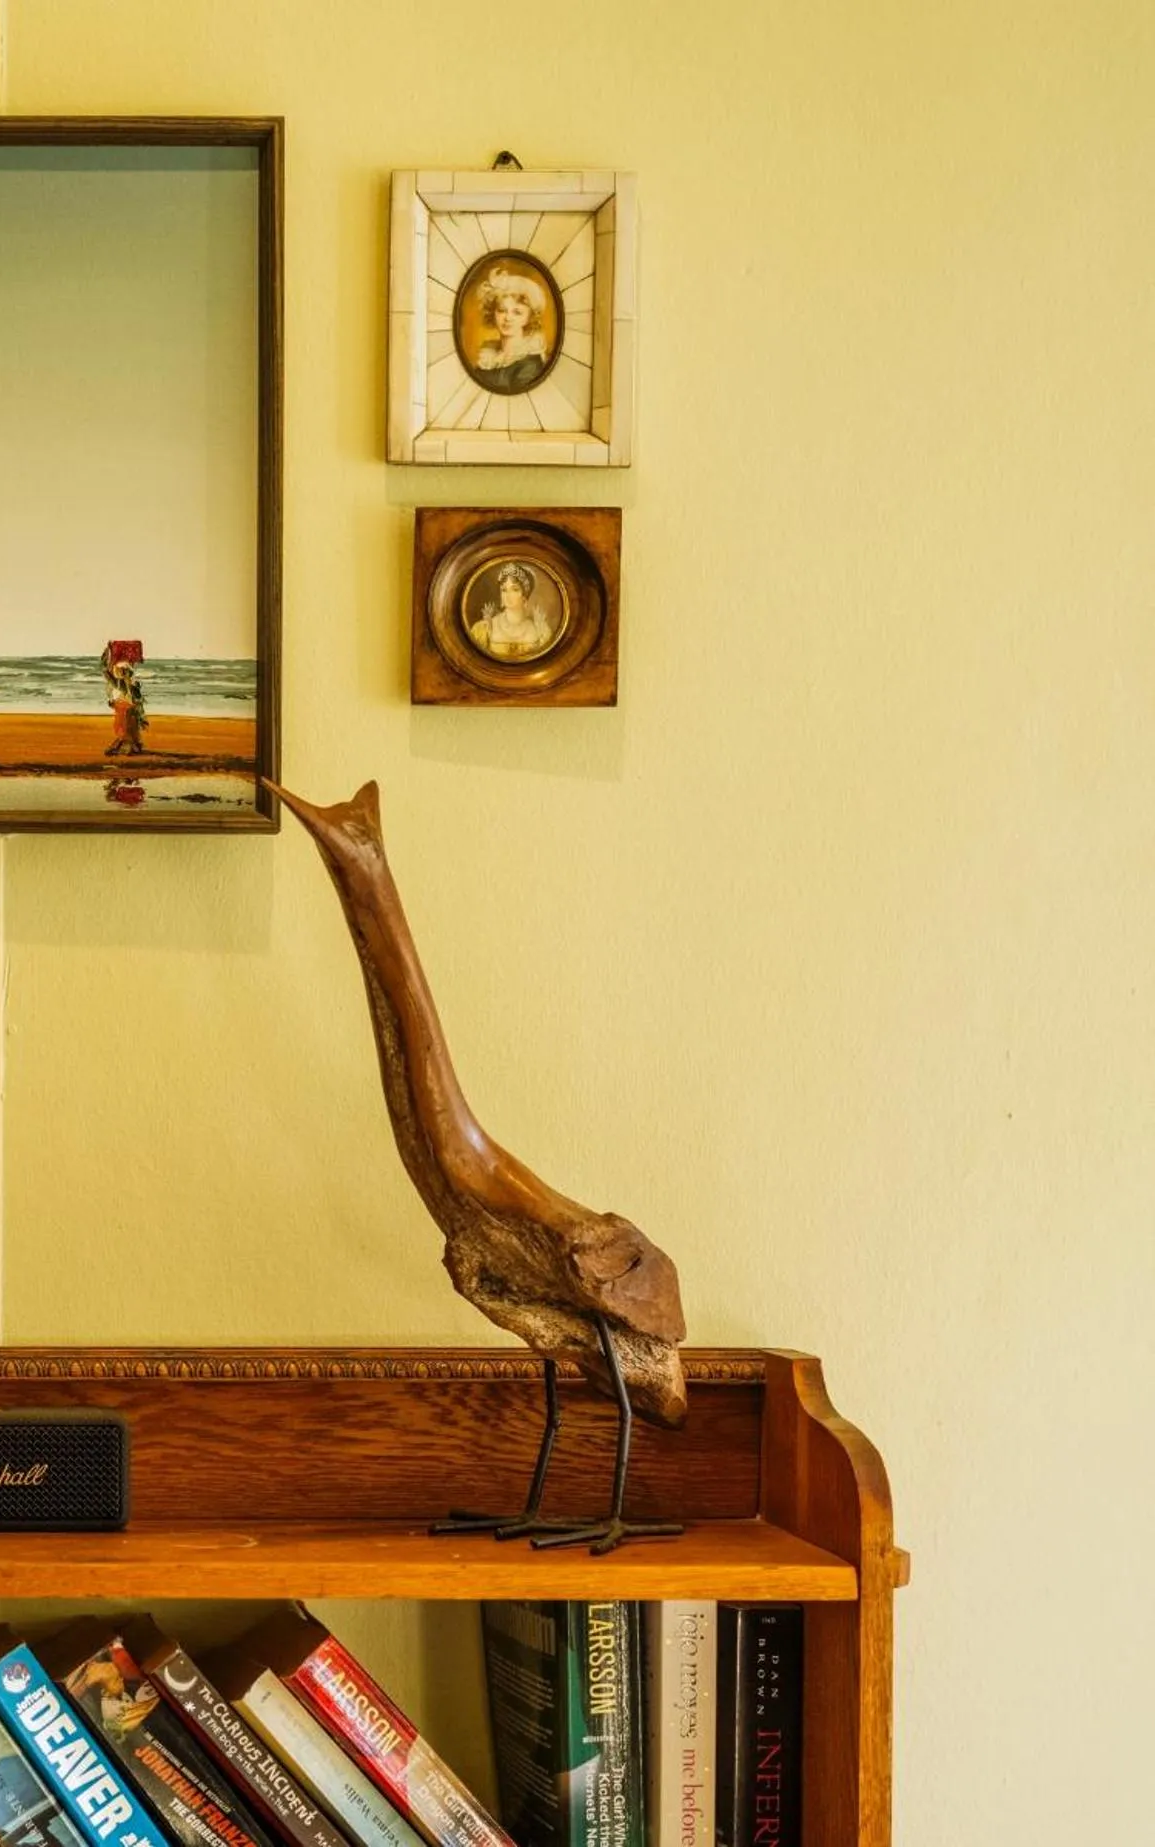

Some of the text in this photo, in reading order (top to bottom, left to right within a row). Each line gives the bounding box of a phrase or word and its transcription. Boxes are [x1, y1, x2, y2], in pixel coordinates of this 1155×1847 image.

[588, 1603, 616, 1714] LARSSON
[756, 1638, 765, 1715] BROWN
[770, 1654, 779, 1698] DAN
[309, 1655, 404, 1758] LARSSON
[673, 1612, 704, 1846] jojo moyes me before
[16, 1689, 137, 1840] DEAVER
[132, 1735, 205, 1818] JONATHAN
[197, 1796, 258, 1847] FRANZ
[338, 1780, 373, 1818] Wallis
[597, 1772, 609, 1821] Kicked
[167, 1796, 189, 1819] THE
[441, 1791, 469, 1821] Girl
[611, 1766, 625, 1847] The Girl Wh
